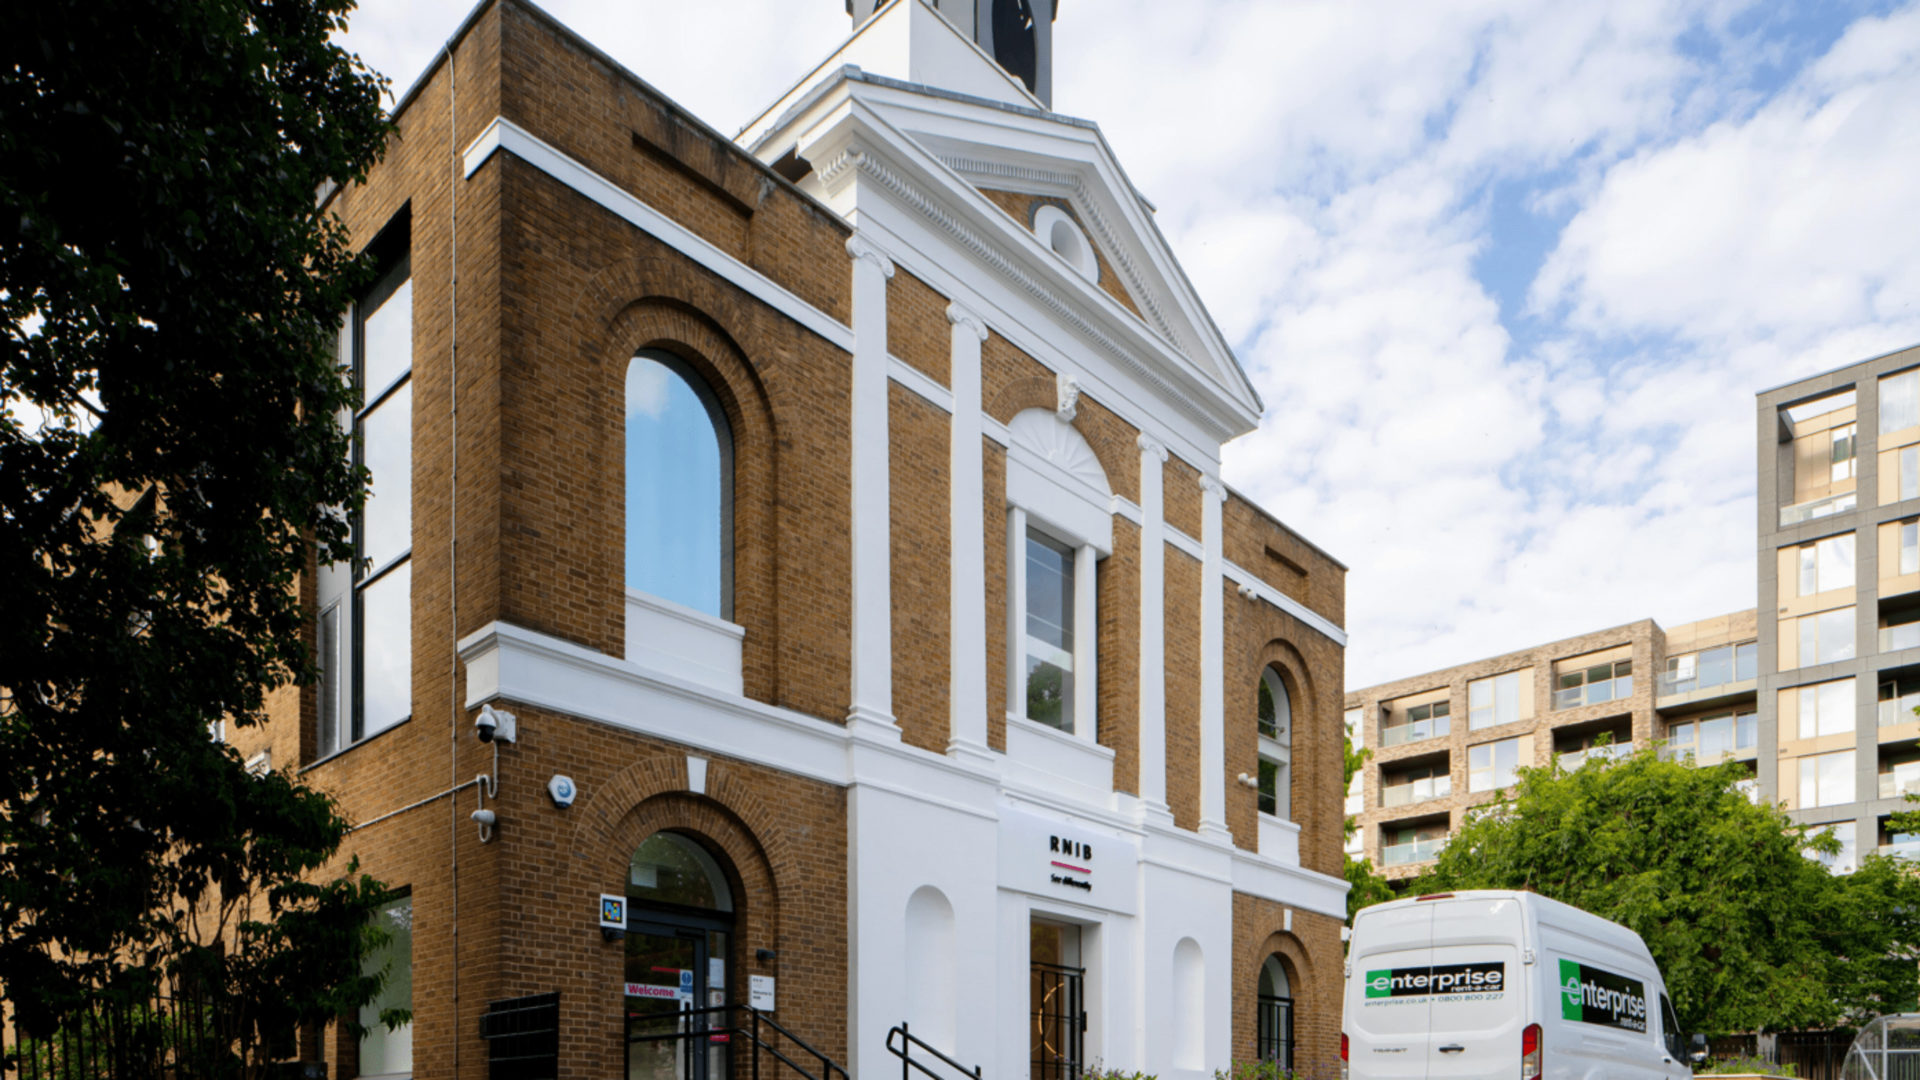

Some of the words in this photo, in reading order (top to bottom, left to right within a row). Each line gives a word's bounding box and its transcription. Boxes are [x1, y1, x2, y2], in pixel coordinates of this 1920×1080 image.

[1050, 834, 1092, 861] RNIB
[1366, 968, 1502, 991] enterprise
[1451, 983, 1502, 993] rent-a-car
[627, 983, 675, 998] Welcome
[1438, 994, 1462, 1003] 0800
[1465, 993, 1483, 1002] 800
[1486, 992, 1504, 1001] 227
[1561, 976, 1645, 1021] enterprise
